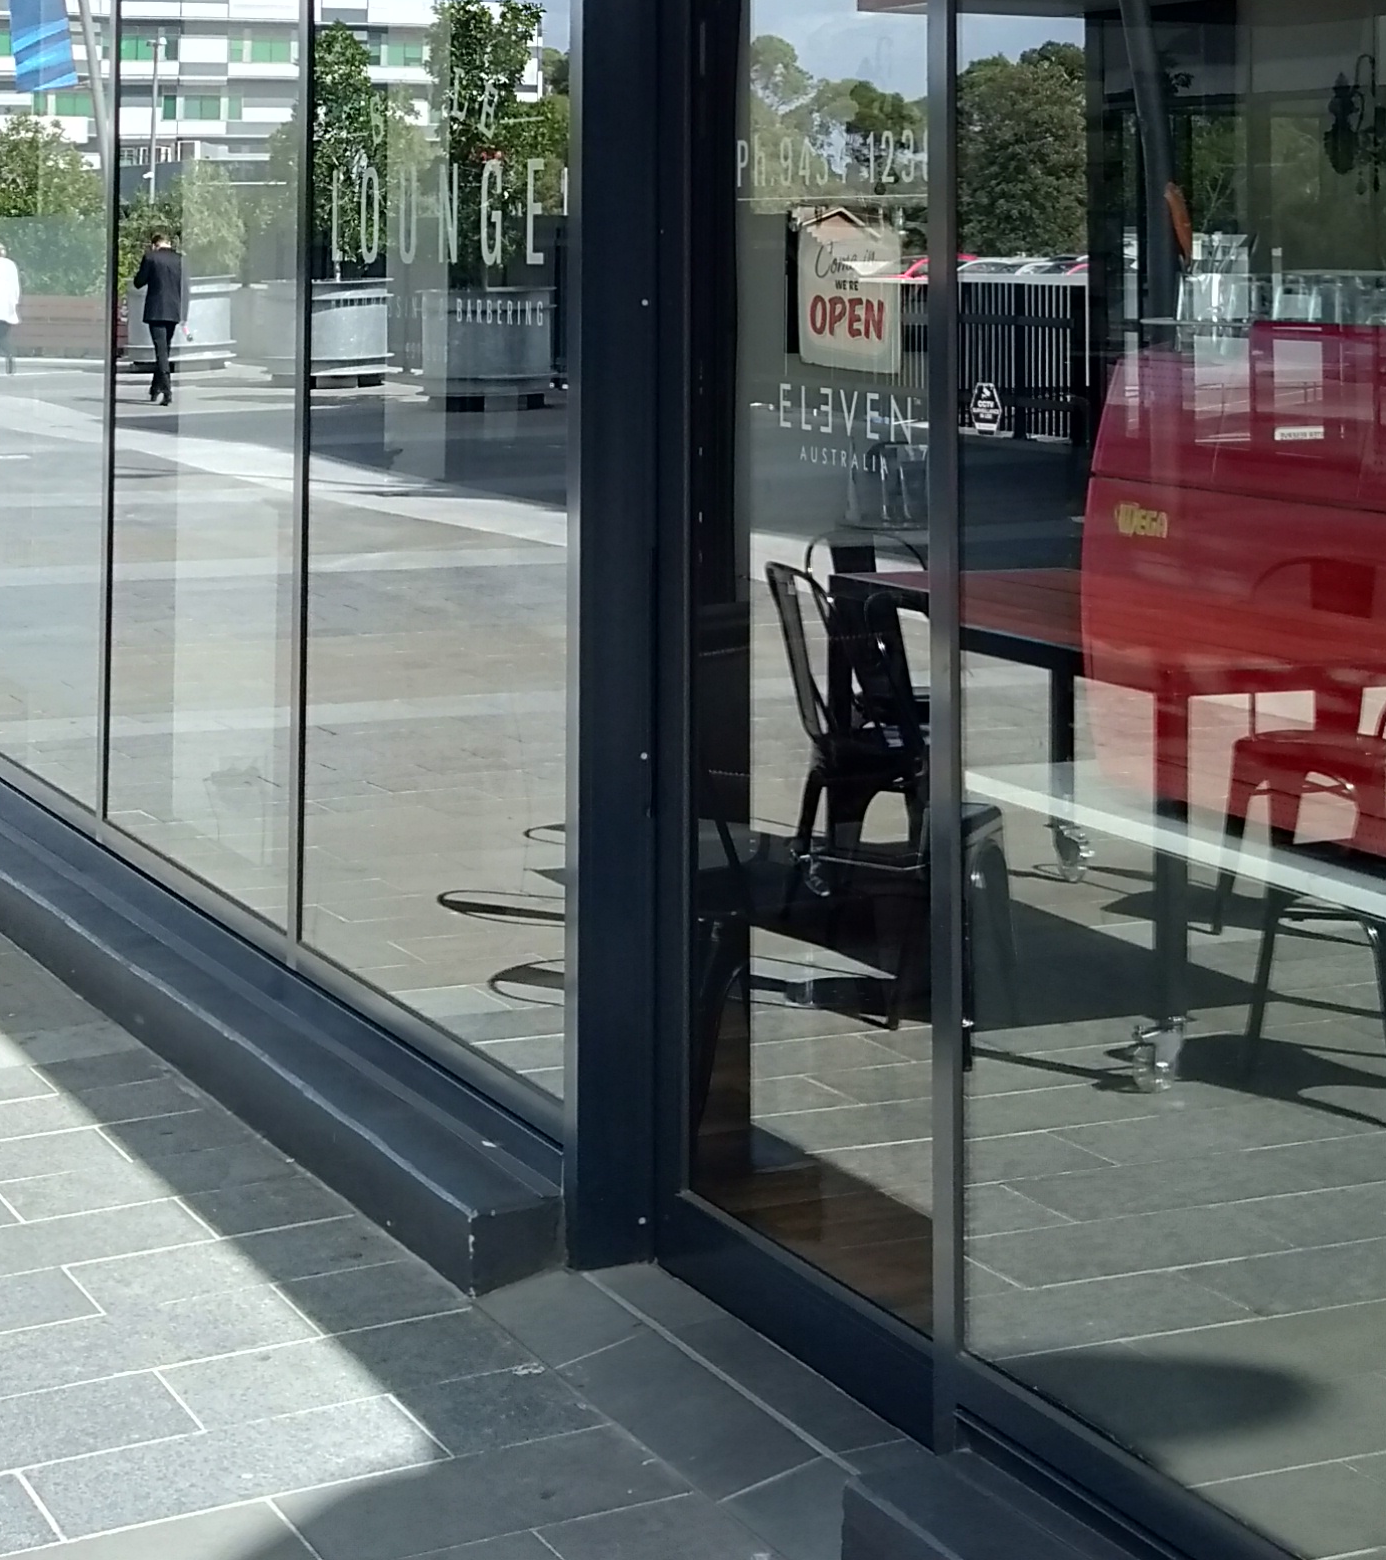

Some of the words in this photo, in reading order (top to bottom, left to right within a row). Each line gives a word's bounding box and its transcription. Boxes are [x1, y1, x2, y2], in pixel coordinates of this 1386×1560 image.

[332, 158, 544, 266] LOUNGE
[456, 298, 544, 327] BARBERING
[809, 294, 885, 341] OPEN
[779, 383, 912, 445] ELEVEN
[800, 445, 889, 474] AUSTRALIA
[1115, 501, 1169, 539] WEGA
